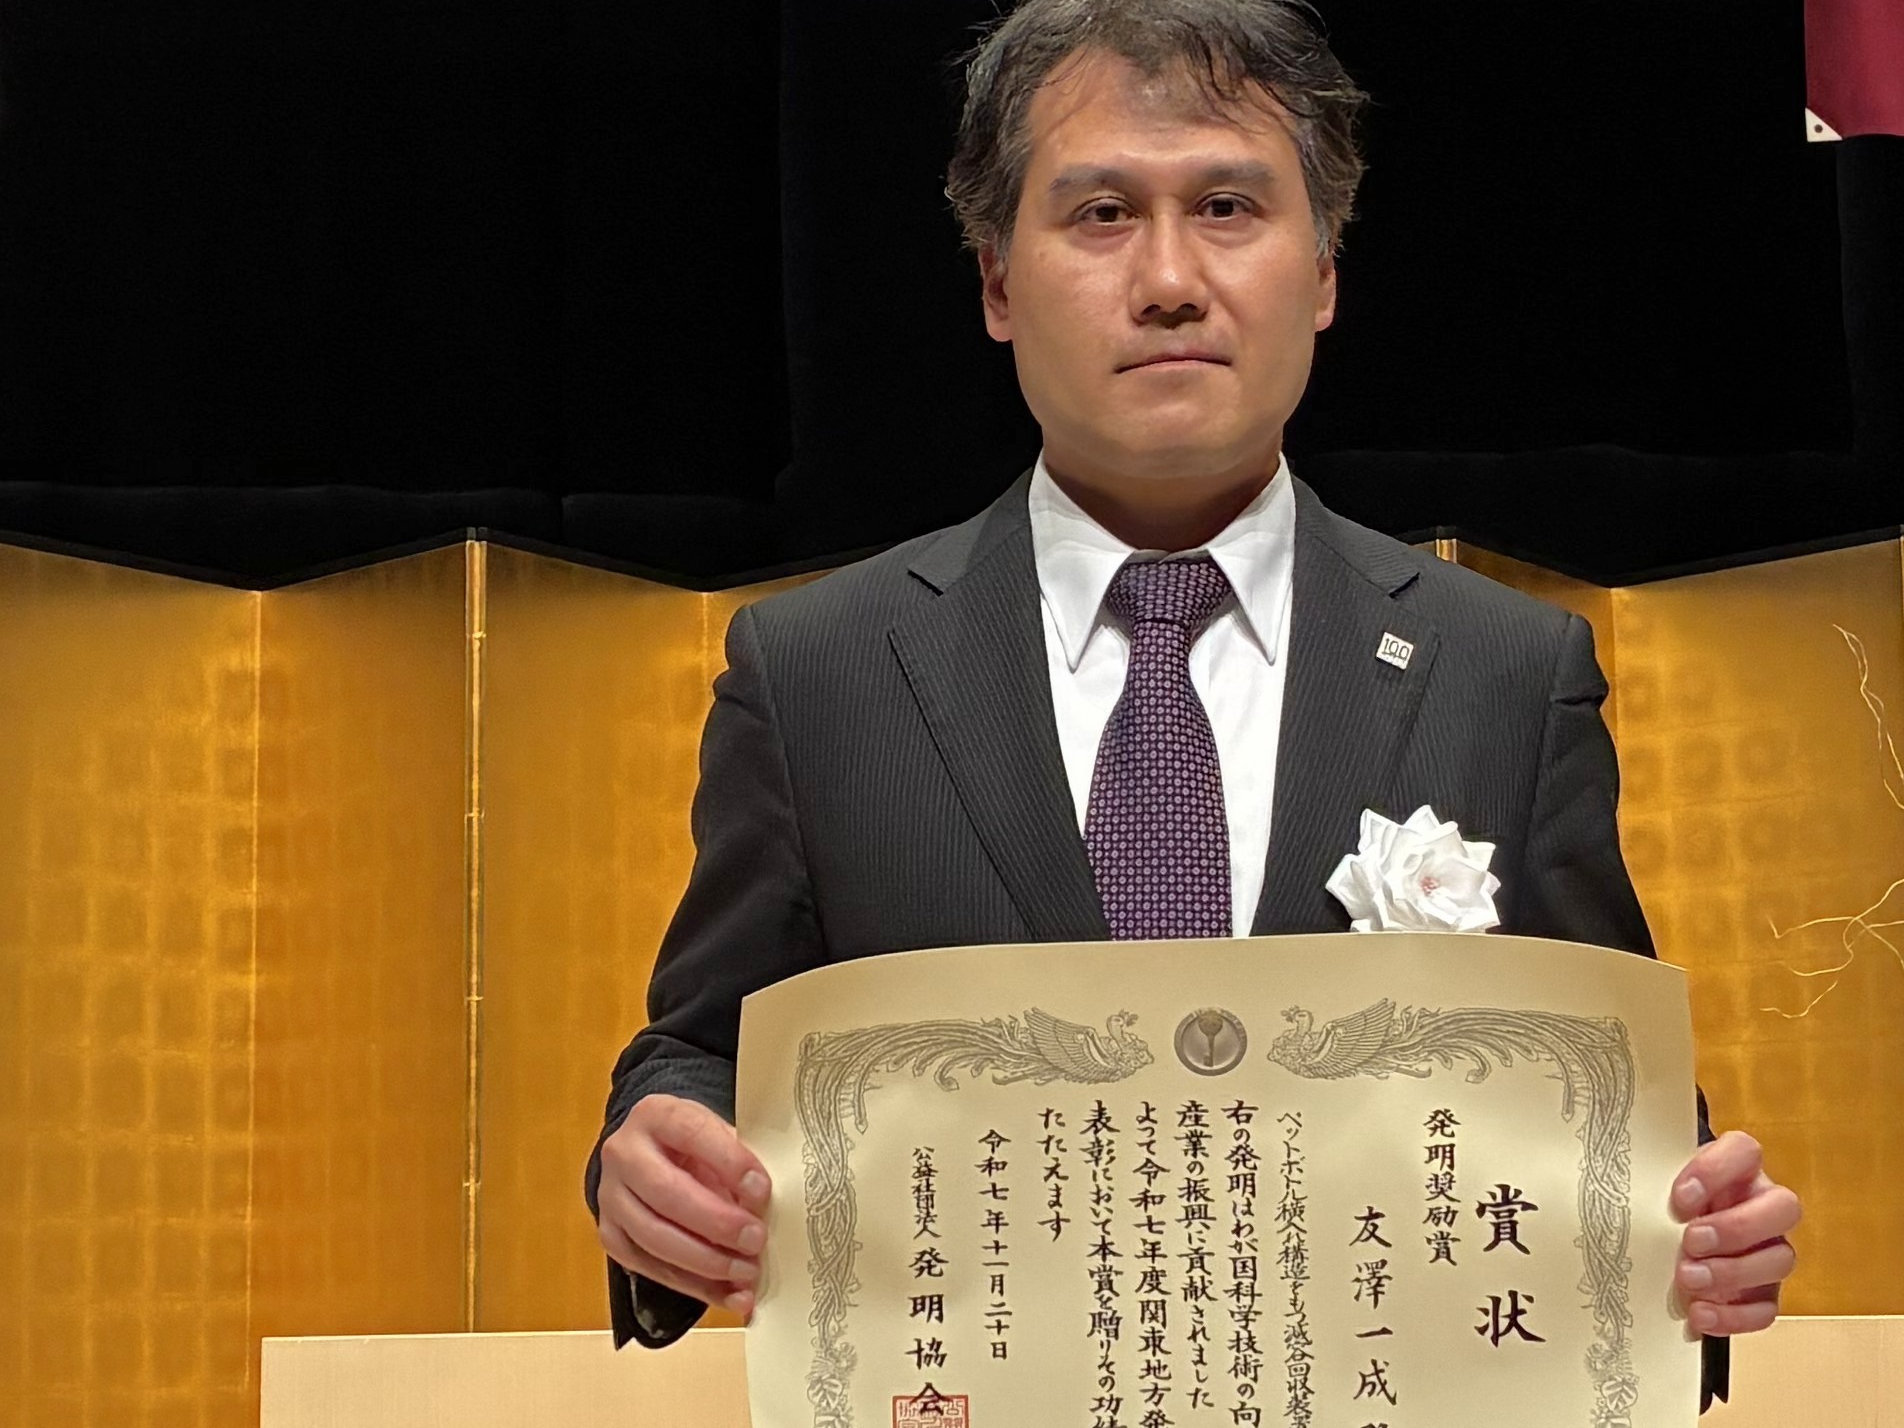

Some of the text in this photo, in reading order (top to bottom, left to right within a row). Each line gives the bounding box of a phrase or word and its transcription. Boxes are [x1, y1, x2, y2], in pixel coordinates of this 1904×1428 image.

[974, 1128, 1013, 1361] 令和七年十一月二十日
[1036, 1107, 1071, 1243] たたえます
[1174, 1099, 1218, 1409] 産業の振興に貢献されました
[1422, 1108, 1462, 1267] 発明奨励賞
[1474, 1183, 1548, 1349] 賞状
